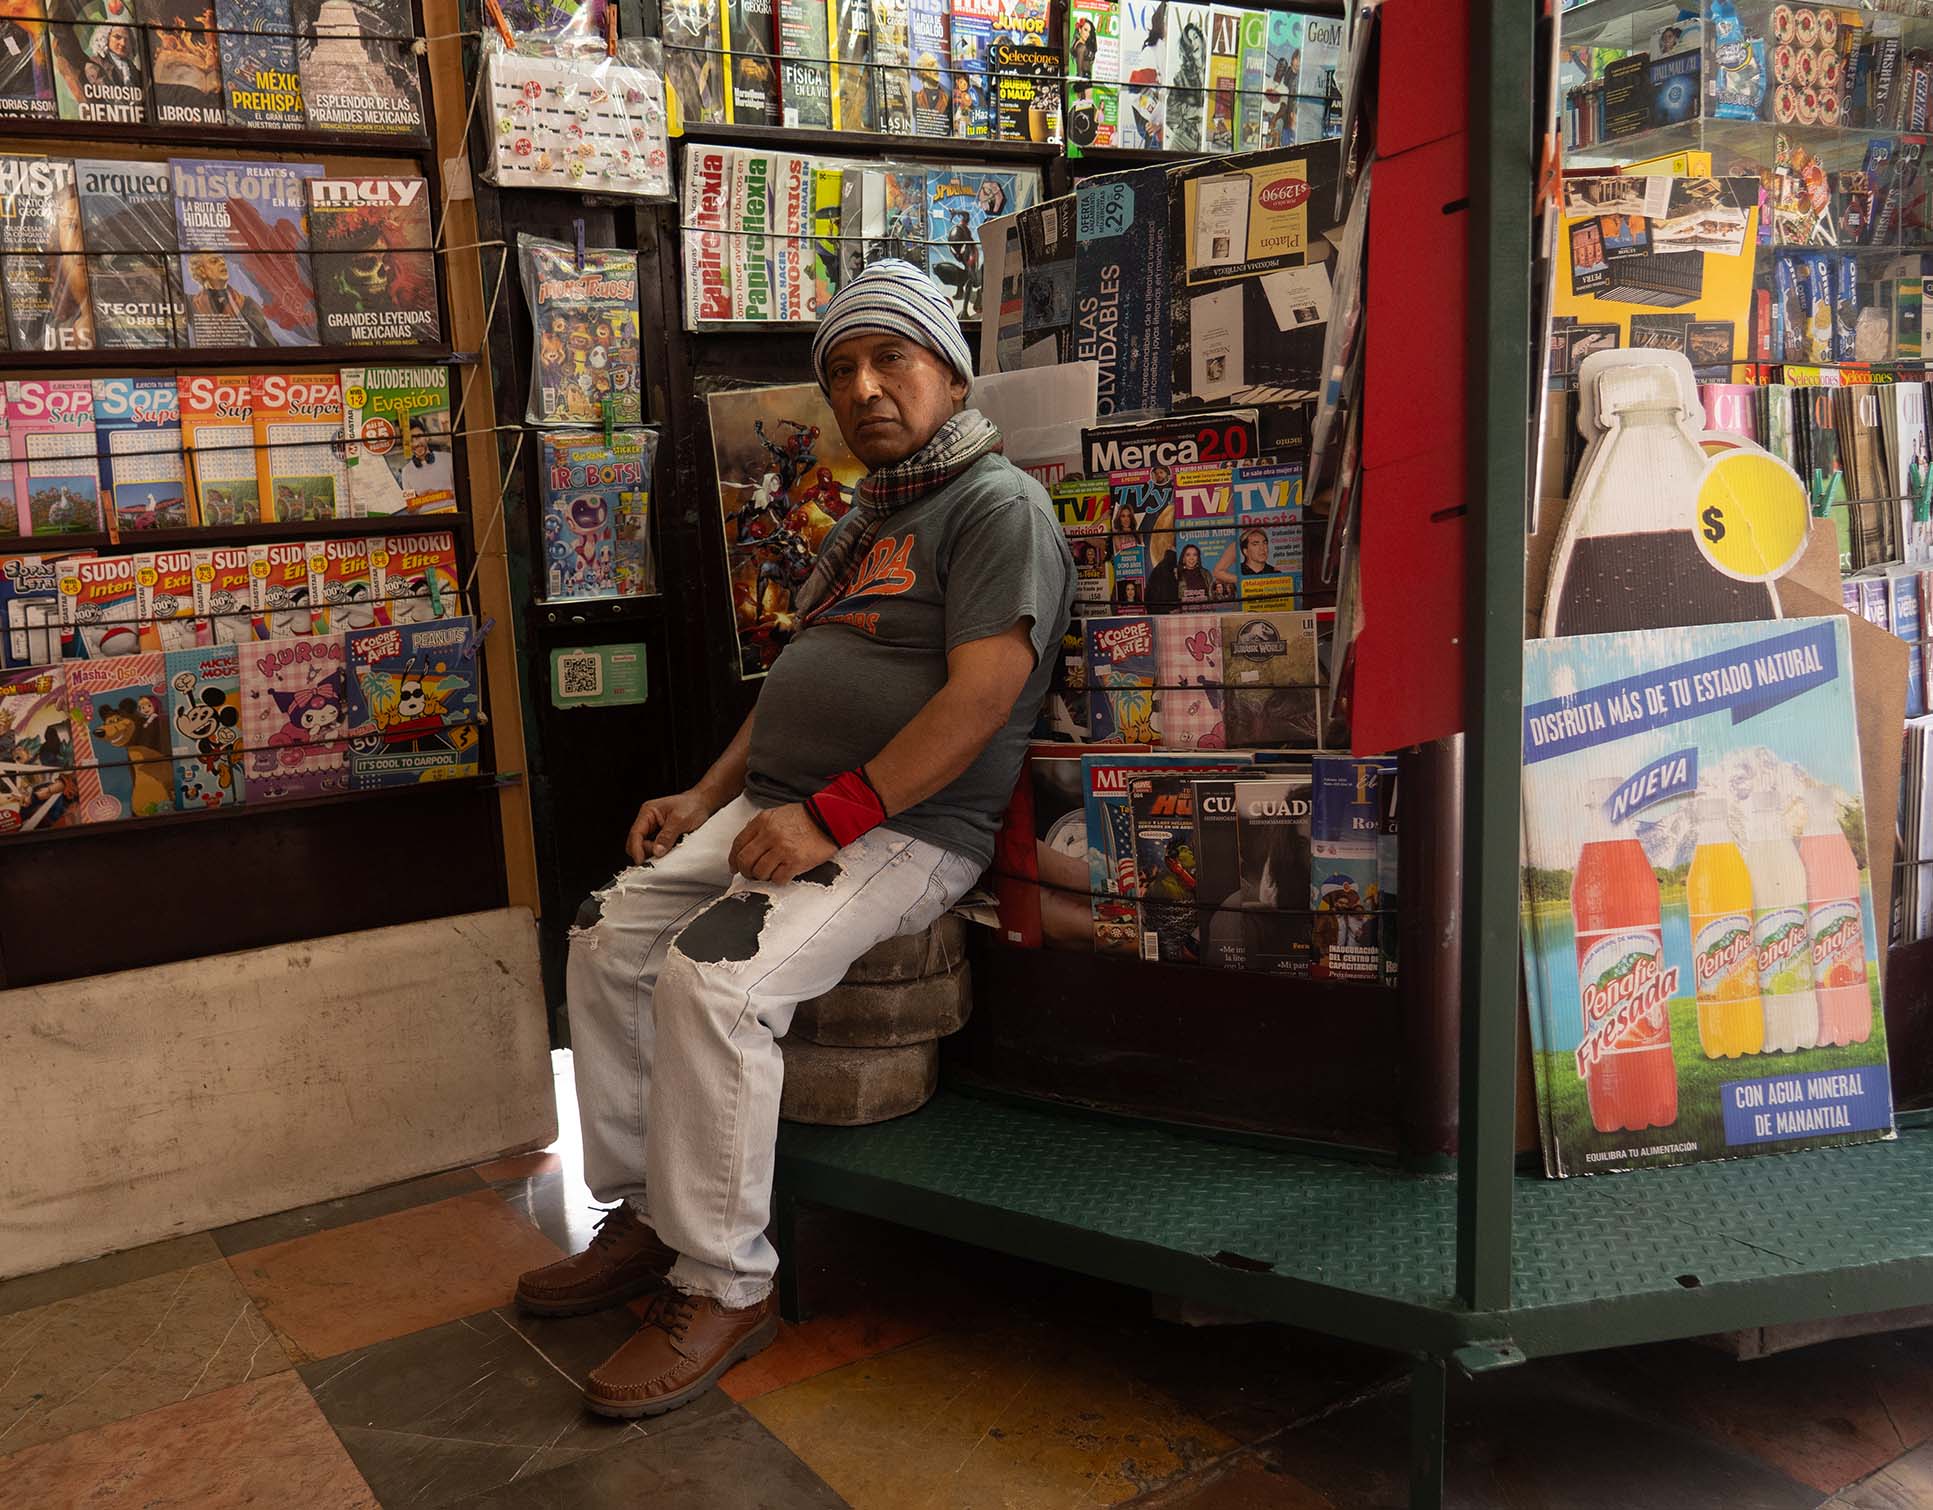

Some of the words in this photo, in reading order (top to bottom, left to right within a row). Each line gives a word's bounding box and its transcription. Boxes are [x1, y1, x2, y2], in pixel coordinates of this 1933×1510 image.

[993, 13, 1045, 34] JUNIOR
[999, 45, 1060, 65] Selecciones
[786, 63, 823, 86] FÍSICA
[84, 84, 143, 101] CURIOSID
[316, 94, 375, 109] ESPLENDOR
[376, 97, 389, 110] DE
[391, 98, 411, 111] LAS
[157, 105, 202, 122] LIBROS
[309, 107, 363, 123] PIRÁMIDES
[364, 110, 421, 125] MEXICANAS
[246, 167, 288, 178] RELATOS
[802, 160, 809, 177] EN
[85, 172, 170, 199] arqueo
[174, 165, 304, 200] historia
[734, 175, 743, 210] barcos
[272, 197, 285, 207] EN
[311, 180, 425, 207] muy
[801, 180, 809, 219] ARMAR
[181, 200, 193, 212] LA
[193, 201, 215, 213] RUTA
[216, 201, 227, 213] DE
[1080, 195, 1090, 234] OFERTA
[183, 212, 232, 229] HIDALGO
[698, 154, 723, 319] Papiroflexia
[743, 158, 768, 320] Papiroflexia
[1260, 234, 1300, 251] Platón
[778, 250, 788, 289] HACER
[1213, 263, 1247, 276] ENTREGA
[1246, 259, 1280, 272] PRÓXIMA
[1818, 261, 1830, 305] OREO
[126, 315, 165, 326] URBE
[327, 312, 378, 327] GRANDES
[379, 310, 432, 326] LEYENDAS
[351, 324, 412, 340] MEXICANAS
[1098, 264, 1121, 416] OLVIDABLES
[366, 368, 447, 390] AUTODEFINIDOS
[1786, 368, 1839, 386] Selecciones
[1840, 367, 1893, 384] Selecciones
[288, 399, 341, 420] Super
[373, 390, 441, 413] Evasión
[1702, 506, 1726, 544] $
[387, 535, 451, 556] SUDOKU
[157, 553, 191, 574] SUD
[402, 552, 441, 571] Élite
[412, 627, 467, 648] PEANUTS
[367, 641, 400, 664] ARTE!
[1113, 637, 1150, 661] ARTE!
[72, 669, 108, 686] Masha
[117, 667, 137, 681] Oso
[1530, 702, 1606, 747] DISFRUTA
[1608, 687, 1644, 725] MÁS
[1647, 683, 1667, 714] DE
[1669, 679, 1692, 710] TU
[1694, 664, 1754, 704] ESTADO
[1754, 644, 1824, 686] NATURAL
[358, 758, 375, 770] IT'S
[376, 757, 400, 769] COOL
[401, 756, 413, 768] TO
[414, 754, 454, 767] CARPOOL
[1611, 757, 1689, 823] NUEVA
[1583, 947, 1664, 1036] Peñafiel
[1576, 966, 1679, 1079] Fresada
[1735, 1084, 1765, 1109] CON
[1768, 1080, 1804, 1105] AGUA
[1807, 1072, 1865, 1101] MINERAL
[1755, 1114, 1773, 1138] DE
[1776, 1105, 1851, 1136] MANANTIAL
[1586, 1149, 1628, 1163] EQUILIBRA
[1628, 1148, 1640, 1159] TU
[1640, 1141, 1698, 1157] ALIMENTACIÓN
